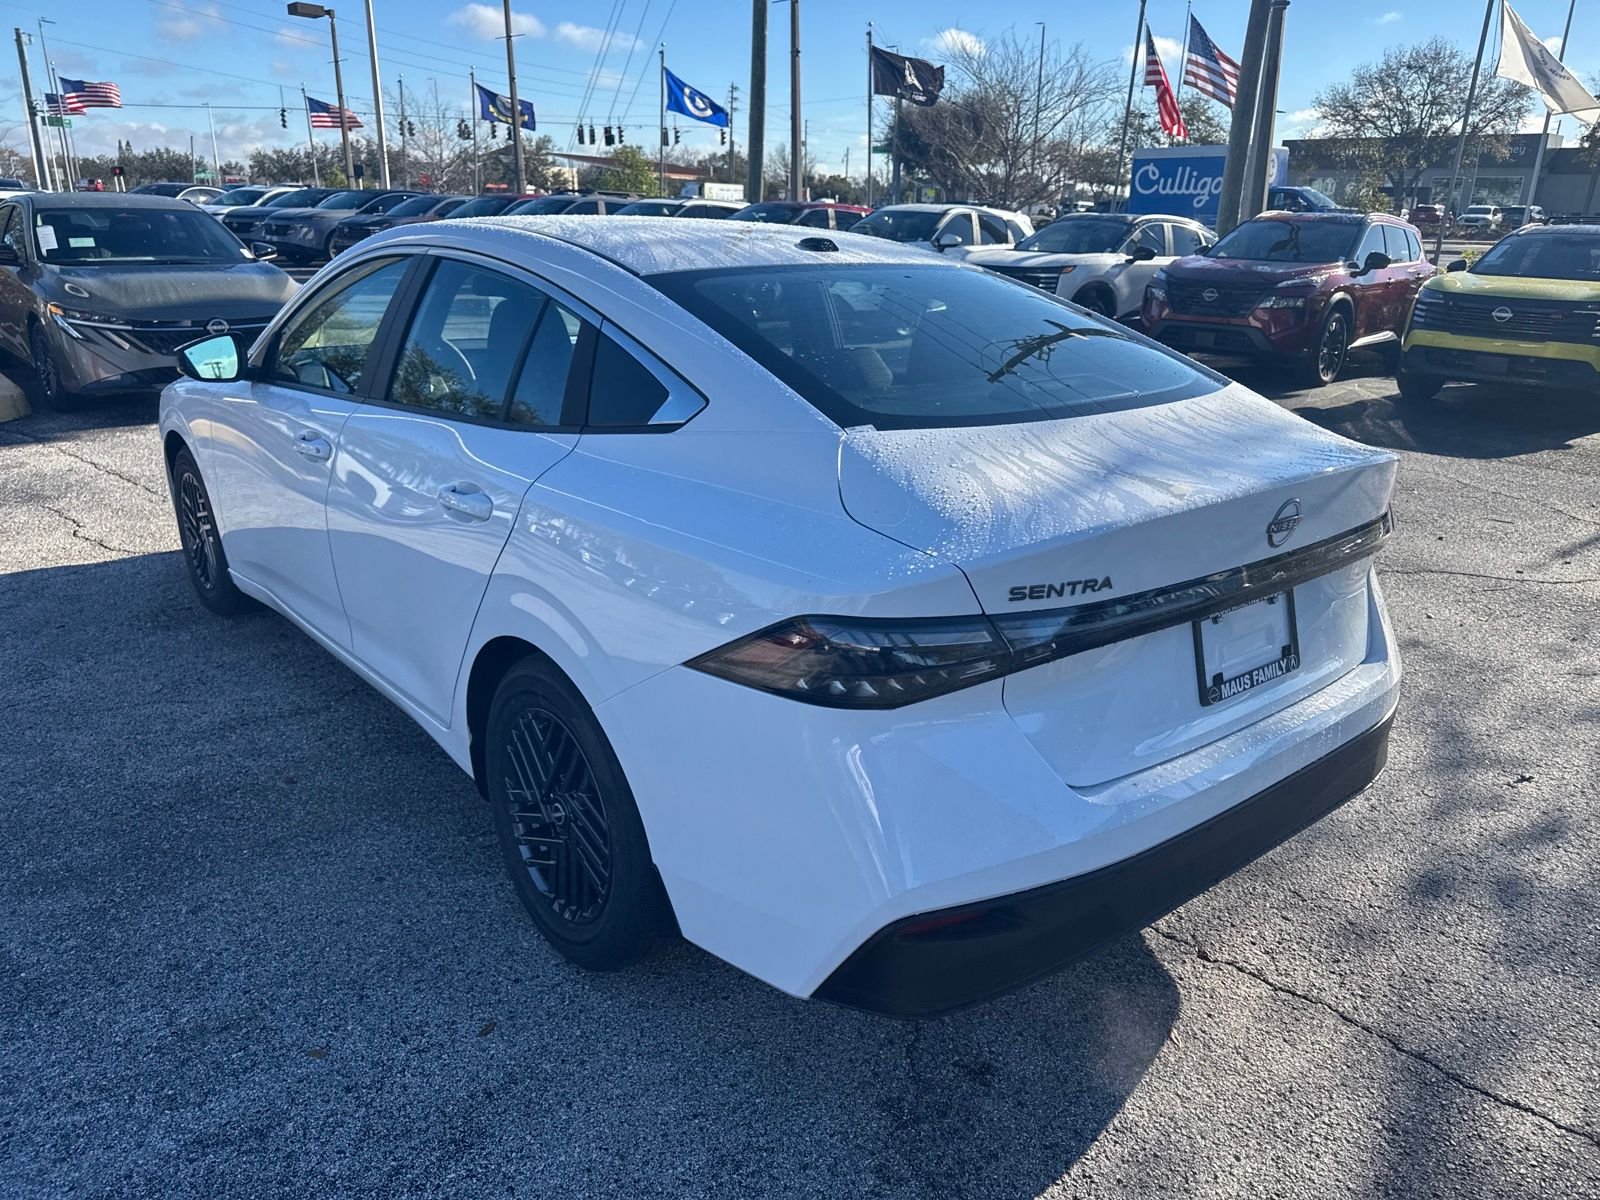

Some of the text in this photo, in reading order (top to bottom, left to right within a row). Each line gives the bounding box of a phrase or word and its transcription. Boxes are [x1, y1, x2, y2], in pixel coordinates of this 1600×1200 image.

[1008, 576, 1113, 602] SENTRA
[1221, 659, 1287, 699] MAUS FAMILY
